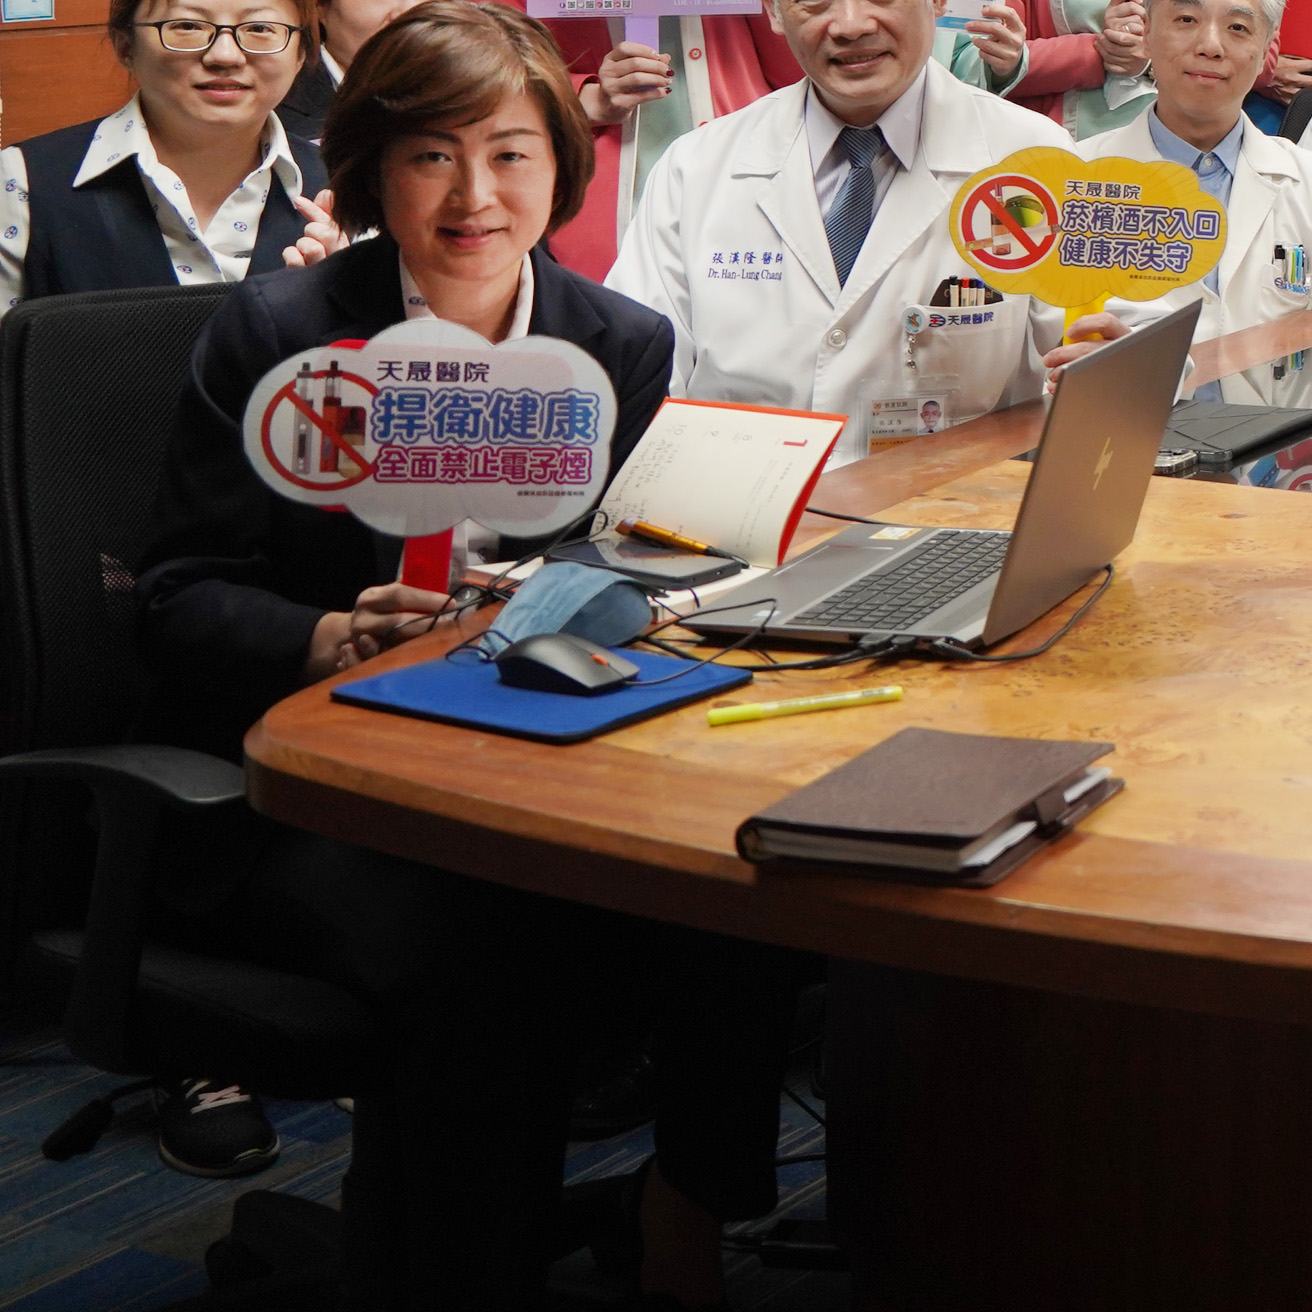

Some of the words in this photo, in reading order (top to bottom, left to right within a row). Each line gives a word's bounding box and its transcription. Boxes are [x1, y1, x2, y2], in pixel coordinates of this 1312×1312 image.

[1065, 180, 1142, 200] 天晟醫院
[1060, 201, 1221, 242] 菸檳酒不入口
[1058, 232, 1193, 274] 健康不失守
[708, 268, 720, 278] Dr.
[721, 269, 760, 281] Han-Lung
[948, 311, 994, 326] 天晟醫院
[376, 360, 491, 384] 天晟醫院
[370, 386, 601, 445] 捍衛健康
[373, 444, 594, 486] 全面禁止電子煙
